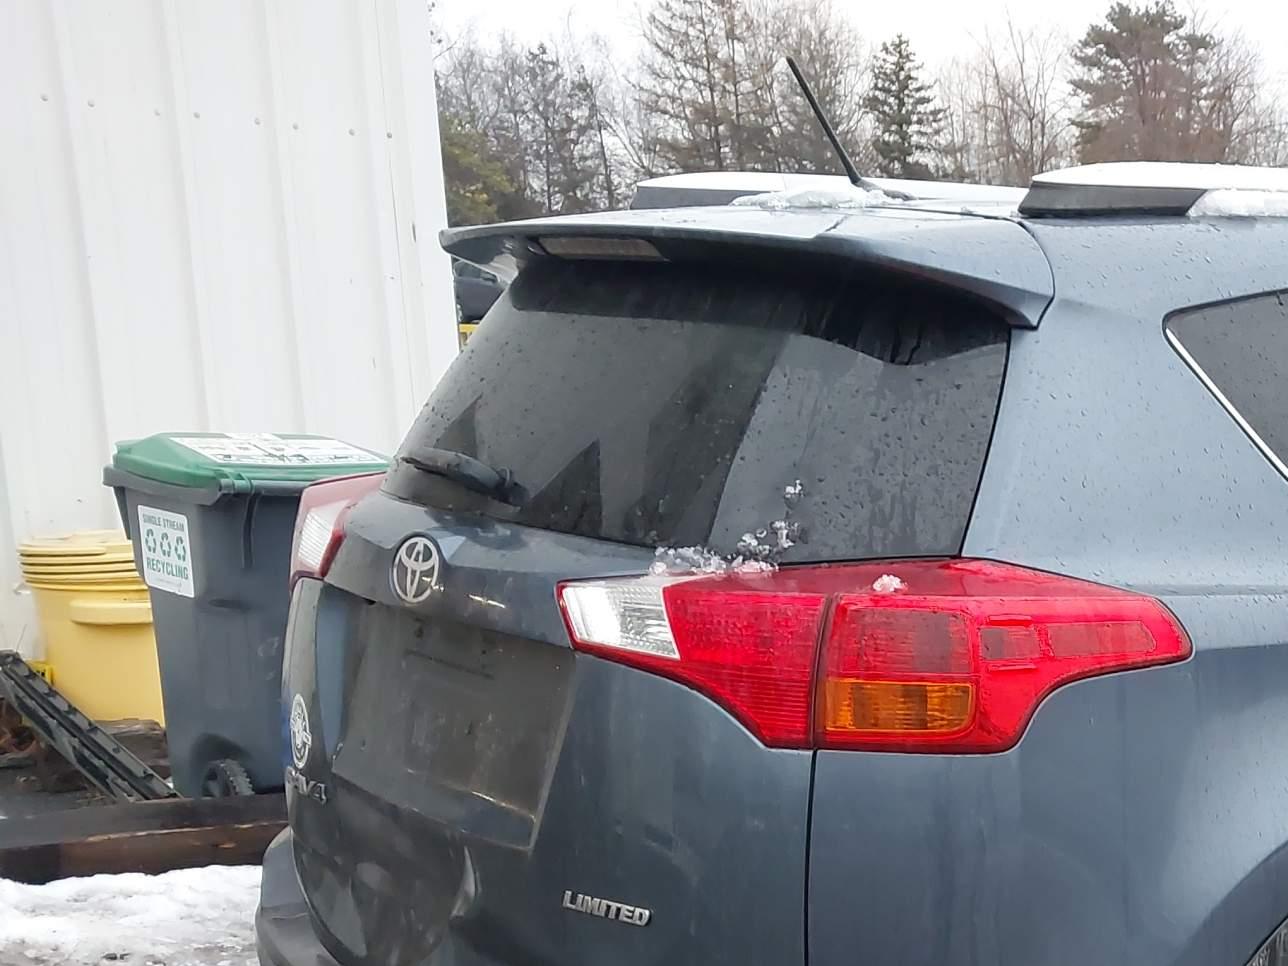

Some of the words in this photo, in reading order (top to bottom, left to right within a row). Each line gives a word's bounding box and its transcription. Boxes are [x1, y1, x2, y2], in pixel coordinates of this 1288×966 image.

[162, 518, 185, 532] STREAM
[146, 556, 189, 580] RECYCLING
[562, 890, 650, 926] LIMITED
